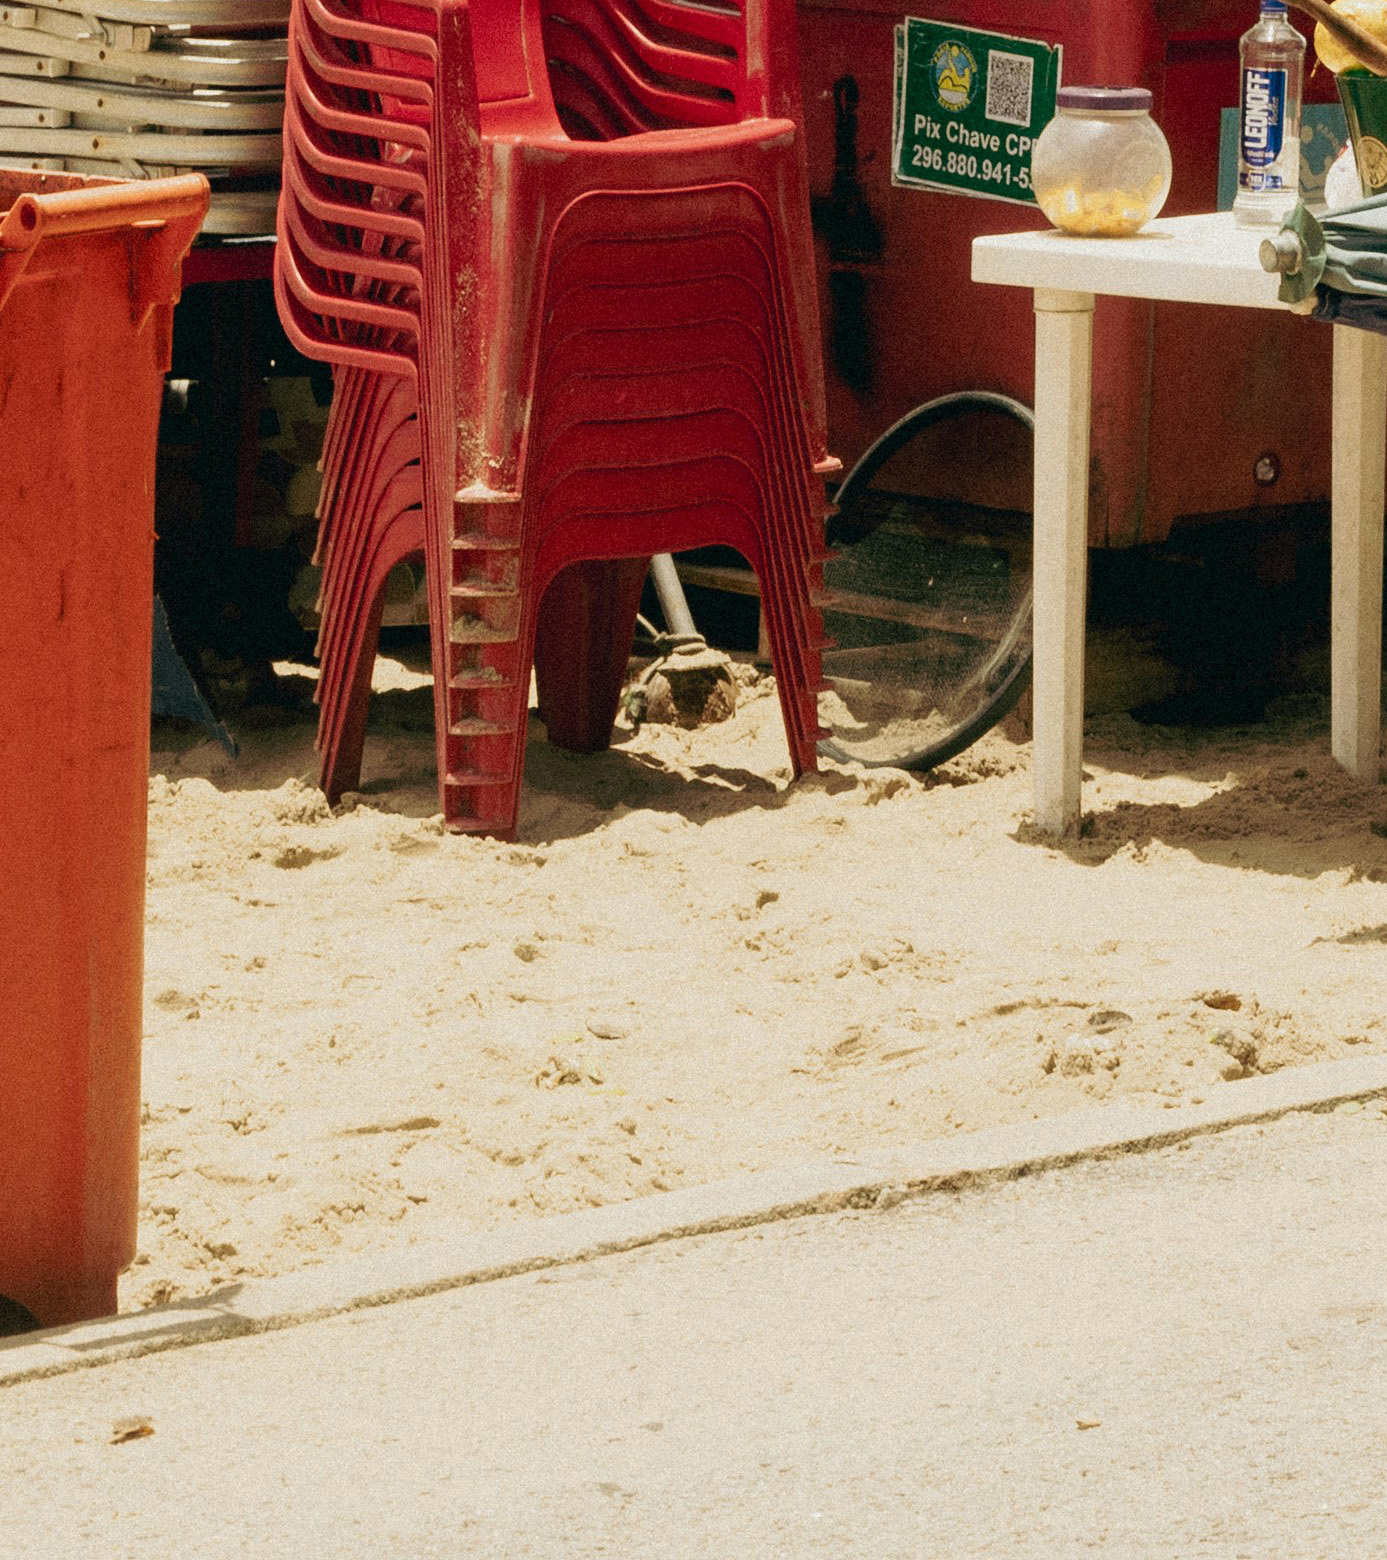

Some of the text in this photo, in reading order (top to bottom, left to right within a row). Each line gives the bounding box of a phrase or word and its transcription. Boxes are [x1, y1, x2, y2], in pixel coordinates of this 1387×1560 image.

[914, 113, 941, 140] Pix
[945, 120, 1001, 152] Chave
[1245, 71, 1271, 149] LEONOFF
